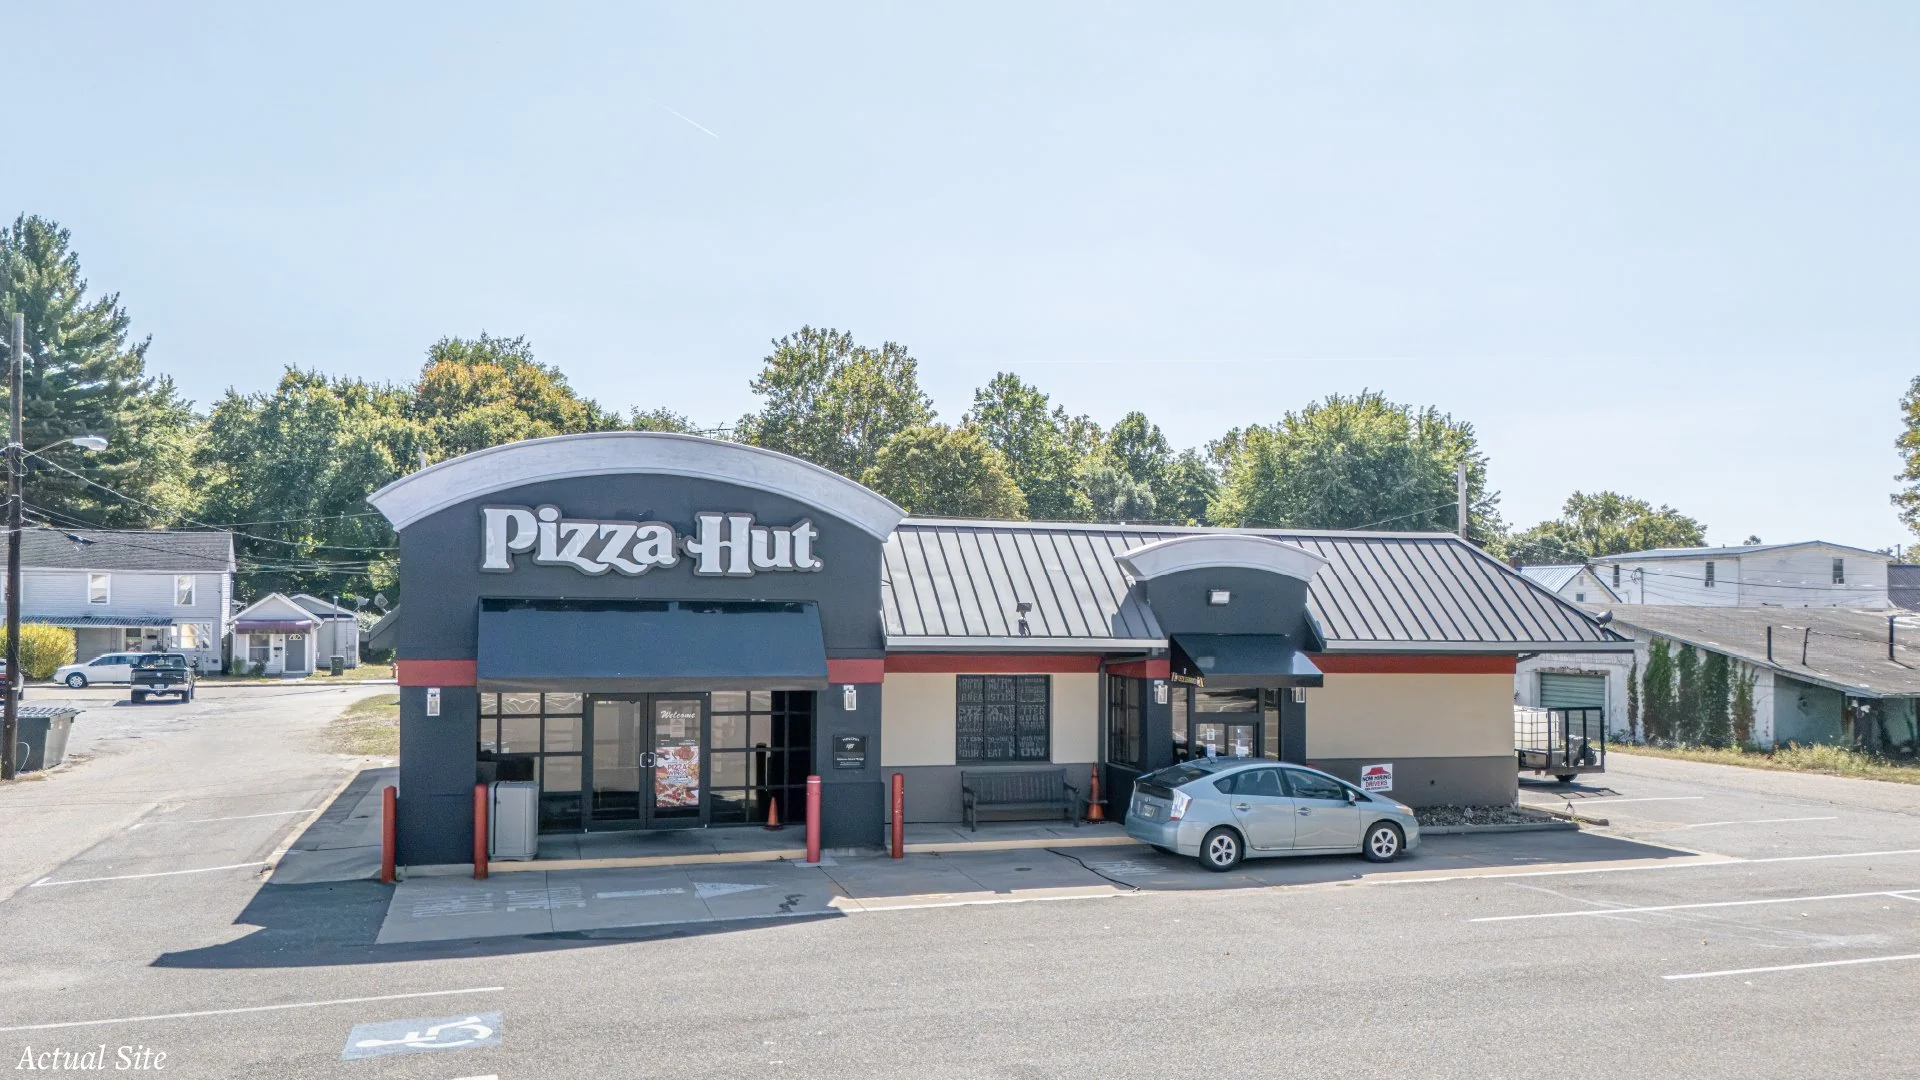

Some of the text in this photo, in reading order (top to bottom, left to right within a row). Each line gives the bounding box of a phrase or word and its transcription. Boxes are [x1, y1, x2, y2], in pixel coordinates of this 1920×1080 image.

[483, 507, 818, 574] Pizza Hut
[660, 710, 696, 719] Welcome
